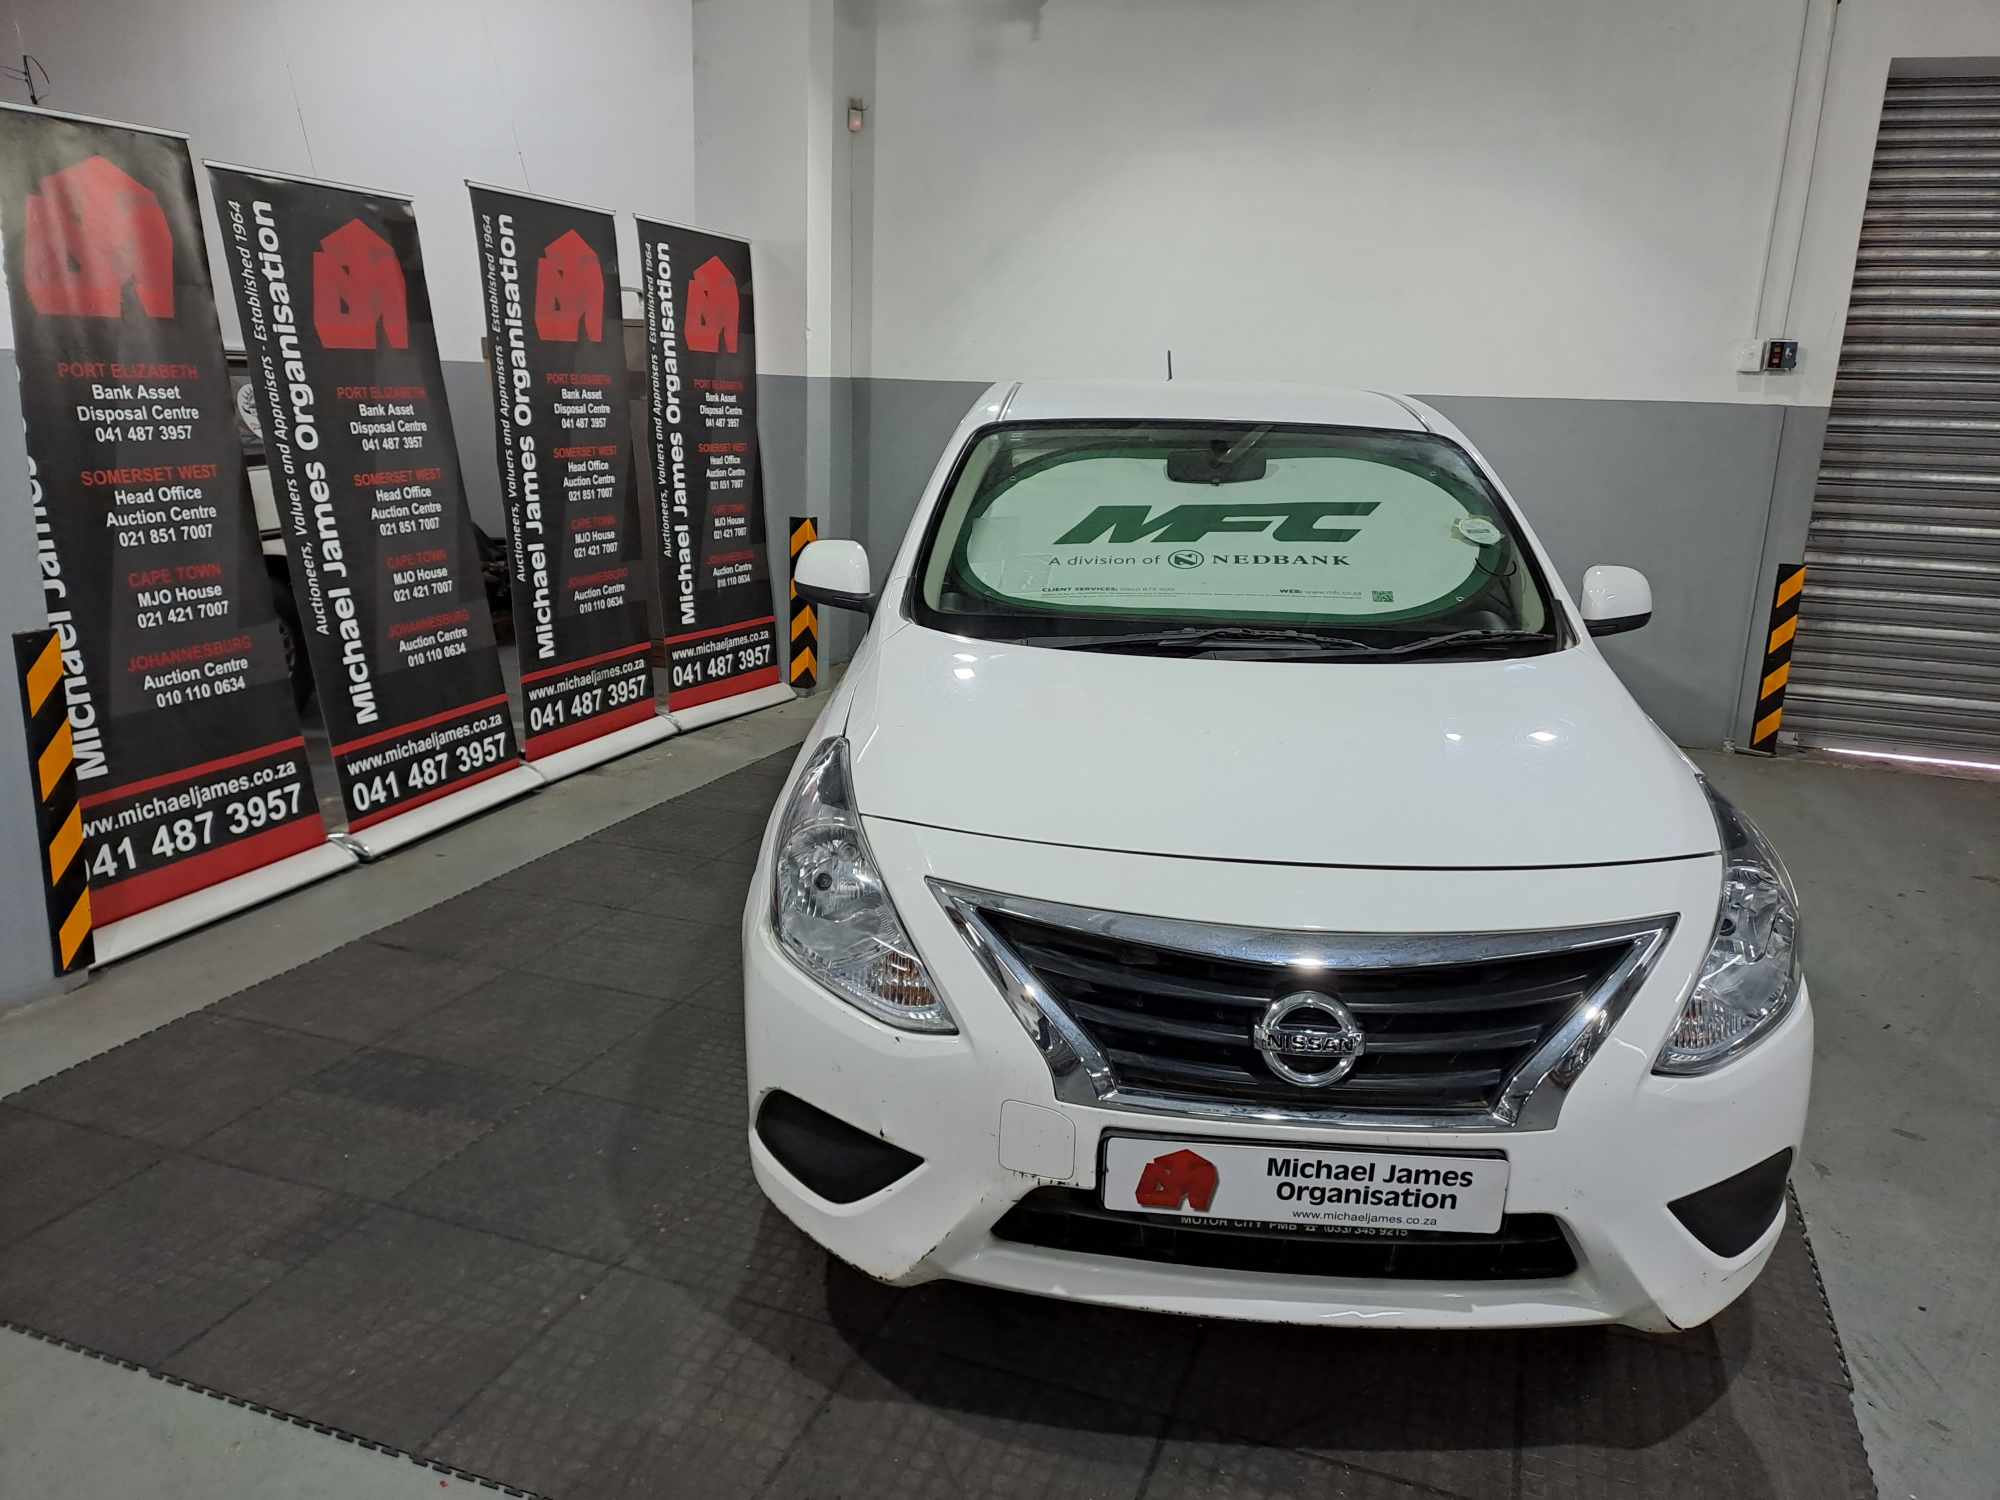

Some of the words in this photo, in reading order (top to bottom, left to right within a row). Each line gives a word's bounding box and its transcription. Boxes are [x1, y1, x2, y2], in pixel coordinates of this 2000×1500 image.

[228, 200, 248, 242] 1964
[482, 214, 495, 249] 1964
[236, 249, 267, 341] Established
[485, 253, 502, 333] Established
[252, 201, 318, 451] Organisation
[499, 214, 532, 426] Organisation
[657, 242, 681, 424] Organisation
[57, 362, 105, 378] PORT
[495, 345, 511, 416] Appraisers
[92, 384, 133, 400] Bank
[137, 384, 181, 400] Asset
[261, 355, 289, 441] Appraisers
[77, 405, 147, 425] Disposal
[152, 404, 200, 420] Centre
[359, 403, 386, 416] Bank
[387, 403, 414, 415] Asset
[95, 427, 122, 442] 041
[128, 426, 153, 441] 487
[160, 425, 192, 440] 3957
[350, 420, 396, 436] Disposal
[397, 420, 428, 432] Centre
[362, 438, 380, 451] 041
[382, 437, 400, 450] 487
[402, 436, 423, 448] 3957
[500, 419, 512, 446] and
[653, 417, 664, 440] and
[81, 468, 174, 486] SOMERSET
[177, 464, 218, 479] WEST
[276, 443, 298, 475] and
[504, 449, 517, 498] Valuers
[657, 443, 667, 485] Valuers
[670, 432, 688, 518] James
[115, 489, 154, 506] Head
[159, 486, 202, 503] Office
[375, 487, 401, 502] Head
[402, 486, 432, 499] Office
[520, 436, 542, 534] James
[563, 476, 591, 487] Auction
[107, 511, 166, 528] Auction
[171, 505, 217, 522] Centre
[285, 479, 307, 535] Valuers
[305, 461, 347, 578] James
[371, 505, 410, 520] Auction
[411, 502, 442, 515] Centre
[1053, 502, 1382, 544] MFC
[119, 531, 145, 547] 021
[150, 528, 176, 544] 851
[181, 524, 213, 541] 7007
[380, 522, 397, 536] 021
[399, 520, 417, 533] 851
[418, 517, 440, 531] 7007
[511, 503, 526, 583] Auctioneers,
[128, 571, 172, 588] CAPE
[177, 564, 222, 581] TOWN
[393, 570, 415, 585] MJO
[416, 567, 448, 581] House
[674, 524, 696, 625] Michael
[1048, 556, 1061, 566] A
[1067, 555, 1136, 566] division
[1142, 554, 1161, 565] of
[1212, 554, 1351, 566] NEDBANK
[138, 588, 172, 608] MJO
[176, 585, 222, 603] House
[301, 542, 329, 635] Auctioneers,
[393, 588, 411, 602] 021
[412, 584, 429, 599] 421
[431, 580, 453, 595] 7007
[528, 543, 555, 660] Michael
[137, 612, 163, 629] 021
[168, 608, 193, 624] 421
[197, 601, 229, 619] 7007
[328, 588, 378, 725] Michael
[399, 635, 436, 653] Auction
[437, 627, 468, 643] Centre
[408, 652, 425, 667] 010
[426, 647, 443, 662] 110
[444, 642, 467, 658] 0634
[143, 665, 201, 690] Auction
[204, 657, 248, 677] Centre
[528, 658, 645, 701] www.michaeljames.co.za
[672, 661, 701, 686] 041
[707, 653, 733, 678] 487
[738, 644, 771, 670] 3957
[47, 610, 109, 781] Michael
[156, 690, 182, 708] 010
[185, 684, 211, 703] 110
[214, 675, 246, 697] 0634
[530, 700, 565, 732] 041
[570, 687, 602, 717] 487
[608, 675, 647, 706] 3957
[347, 712, 502, 776] www.michaeljames.co.za
[352, 770, 400, 812] 041
[408, 752, 449, 790] 487
[456, 732, 507, 772] 3957
[83, 760, 297, 839] ww.michaeljames.co.za
[85, 837, 136, 882] 41
[152, 811, 214, 858] 487
[226, 782, 302, 834] 3957
[1267, 1033, 1354, 1052] NISSAN
[1267, 1156, 1376, 1183] Michael
[1382, 1164, 1474, 1188] James
[1275, 1180, 1459, 1211] Organisation
[1292, 1209, 1438, 1226] www.michaeljames.co.za
